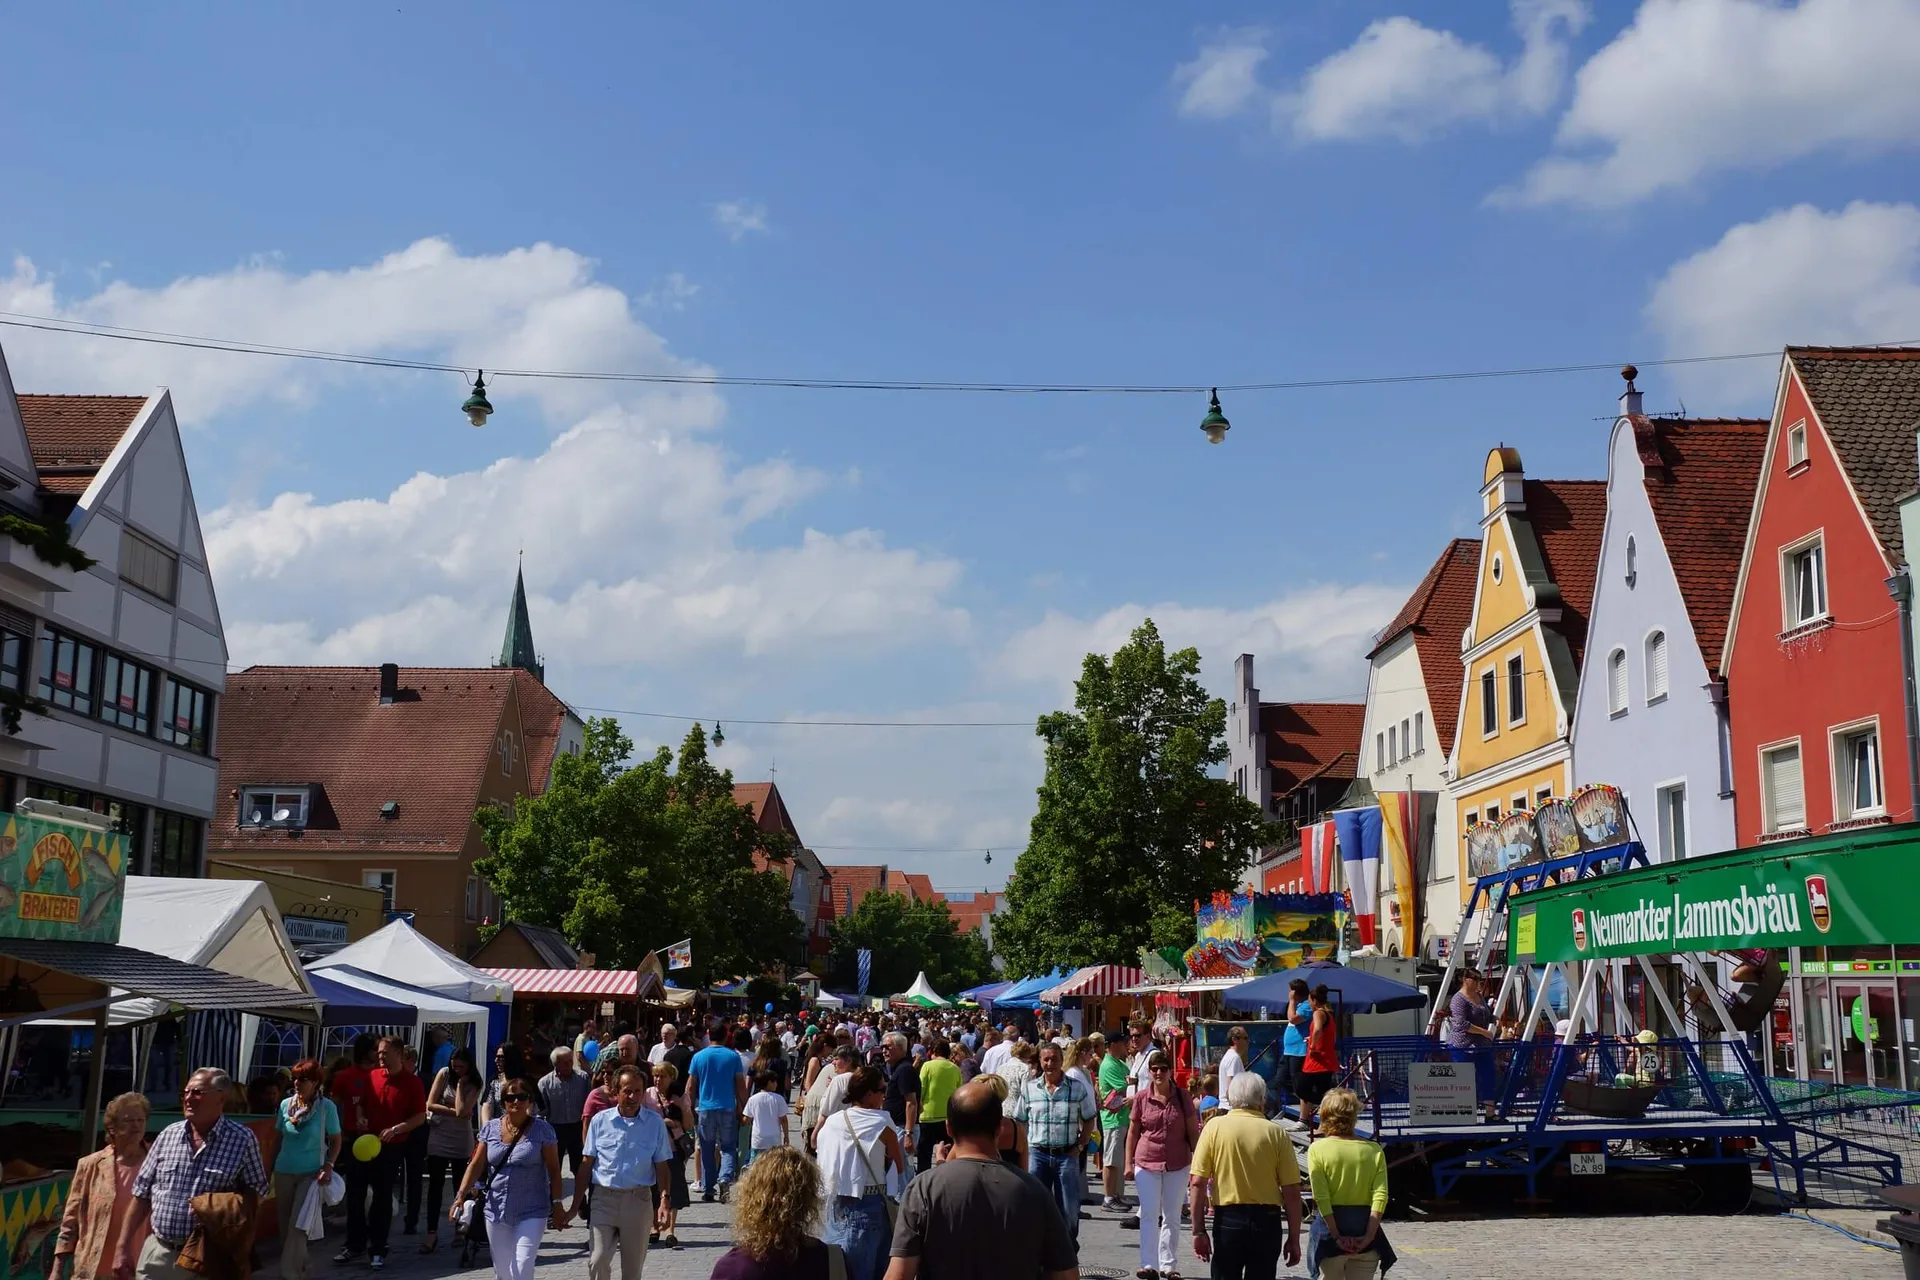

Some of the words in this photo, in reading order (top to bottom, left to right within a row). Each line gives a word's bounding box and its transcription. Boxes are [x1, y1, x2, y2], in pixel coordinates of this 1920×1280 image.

[36, 834, 76, 862] FISCH
[22, 893, 79, 919] BRATEREI
[1590, 898, 1671, 948] Neumarkter
[1674, 883, 1802, 939] Lammsbräu
[286, 921, 313, 937] GASTHAUS
[1803, 962, 1825, 973] GRAVIS
[1644, 1056, 1657, 1069] 25
[1580, 1155, 1596, 1164] NM
[1573, 1164, 1587, 1173] CA
[1592, 1164, 1603, 1173] 89
